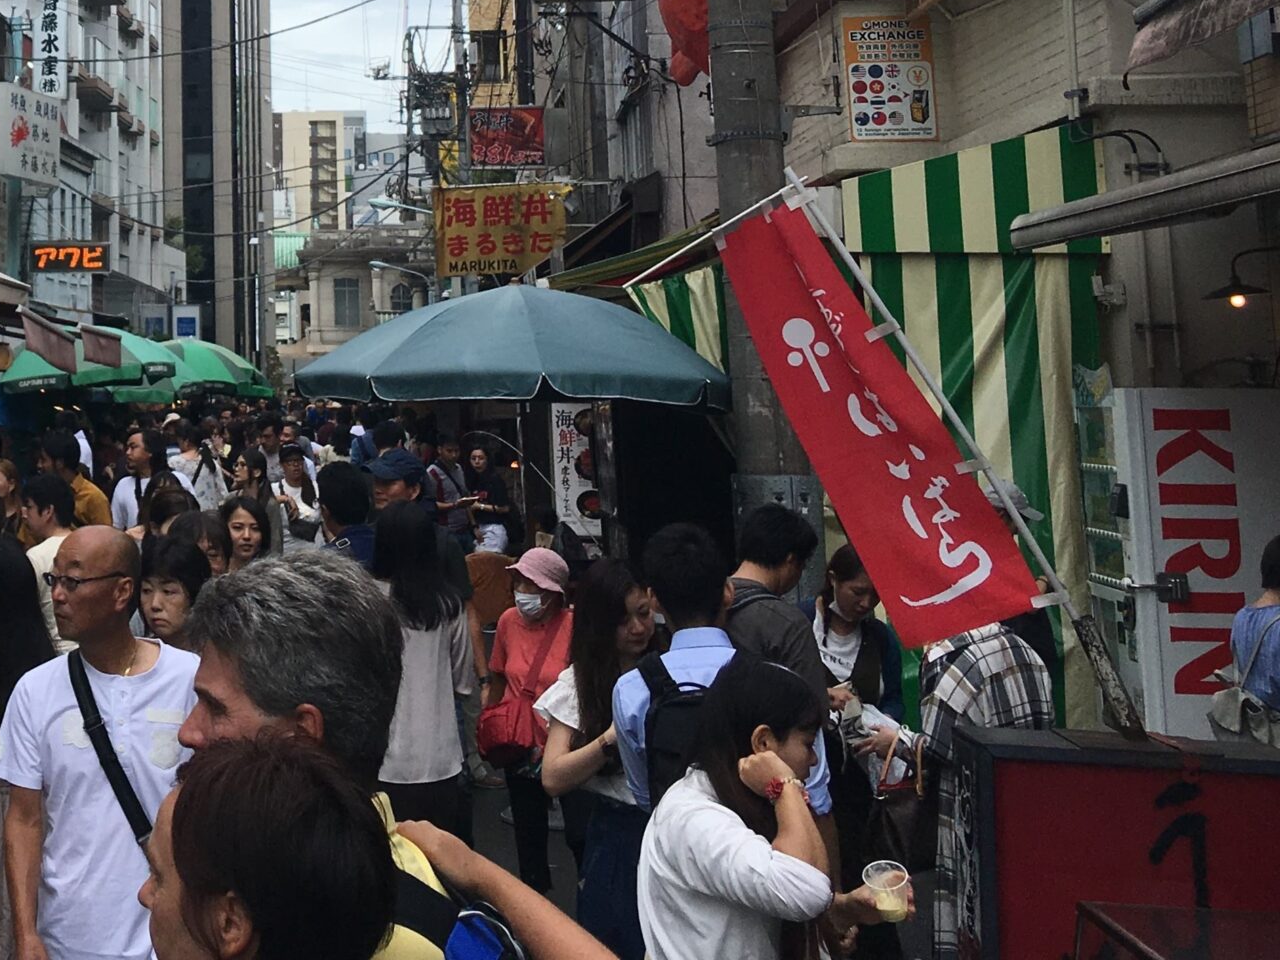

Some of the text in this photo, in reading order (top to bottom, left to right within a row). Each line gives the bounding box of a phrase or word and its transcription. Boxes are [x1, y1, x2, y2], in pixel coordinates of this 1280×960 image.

[849, 30, 926, 41] EXCHANGE
[871, 20, 910, 29] MONEY
[444, 192, 553, 228] 海鮮丼
[447, 231, 553, 258] まるきた
[34, 246, 103, 269] アワビ
[449, 258, 518, 274] MARUKITA
[555, 409, 577, 465] 海鮮丼
[1152, 407, 1246, 696] KIRIN
